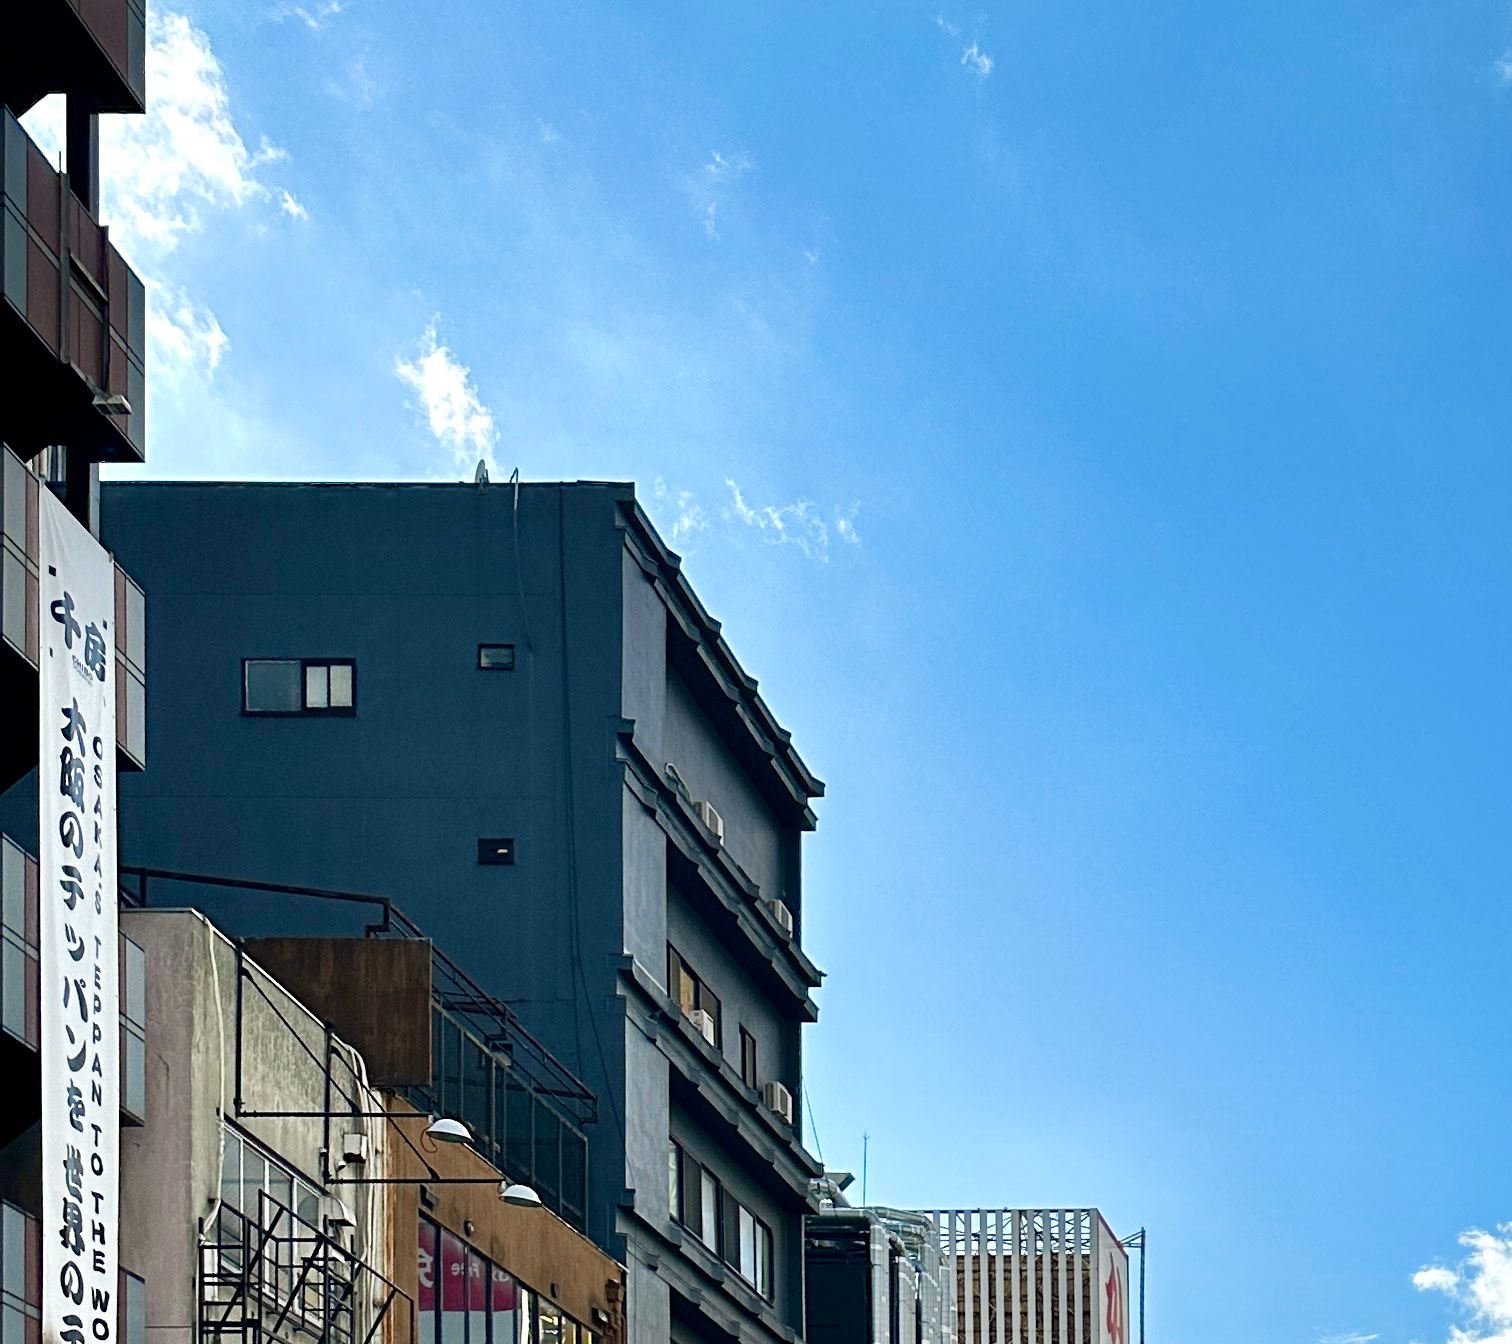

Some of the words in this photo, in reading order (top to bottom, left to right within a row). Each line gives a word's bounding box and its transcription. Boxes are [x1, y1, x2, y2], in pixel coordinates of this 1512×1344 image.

[92, 735, 103, 915] OSAKA'S
[91, 934, 103, 1107] TEPPAN
[90, 1123, 103, 1177] TO
[91, 1190, 106, 1274] THE
